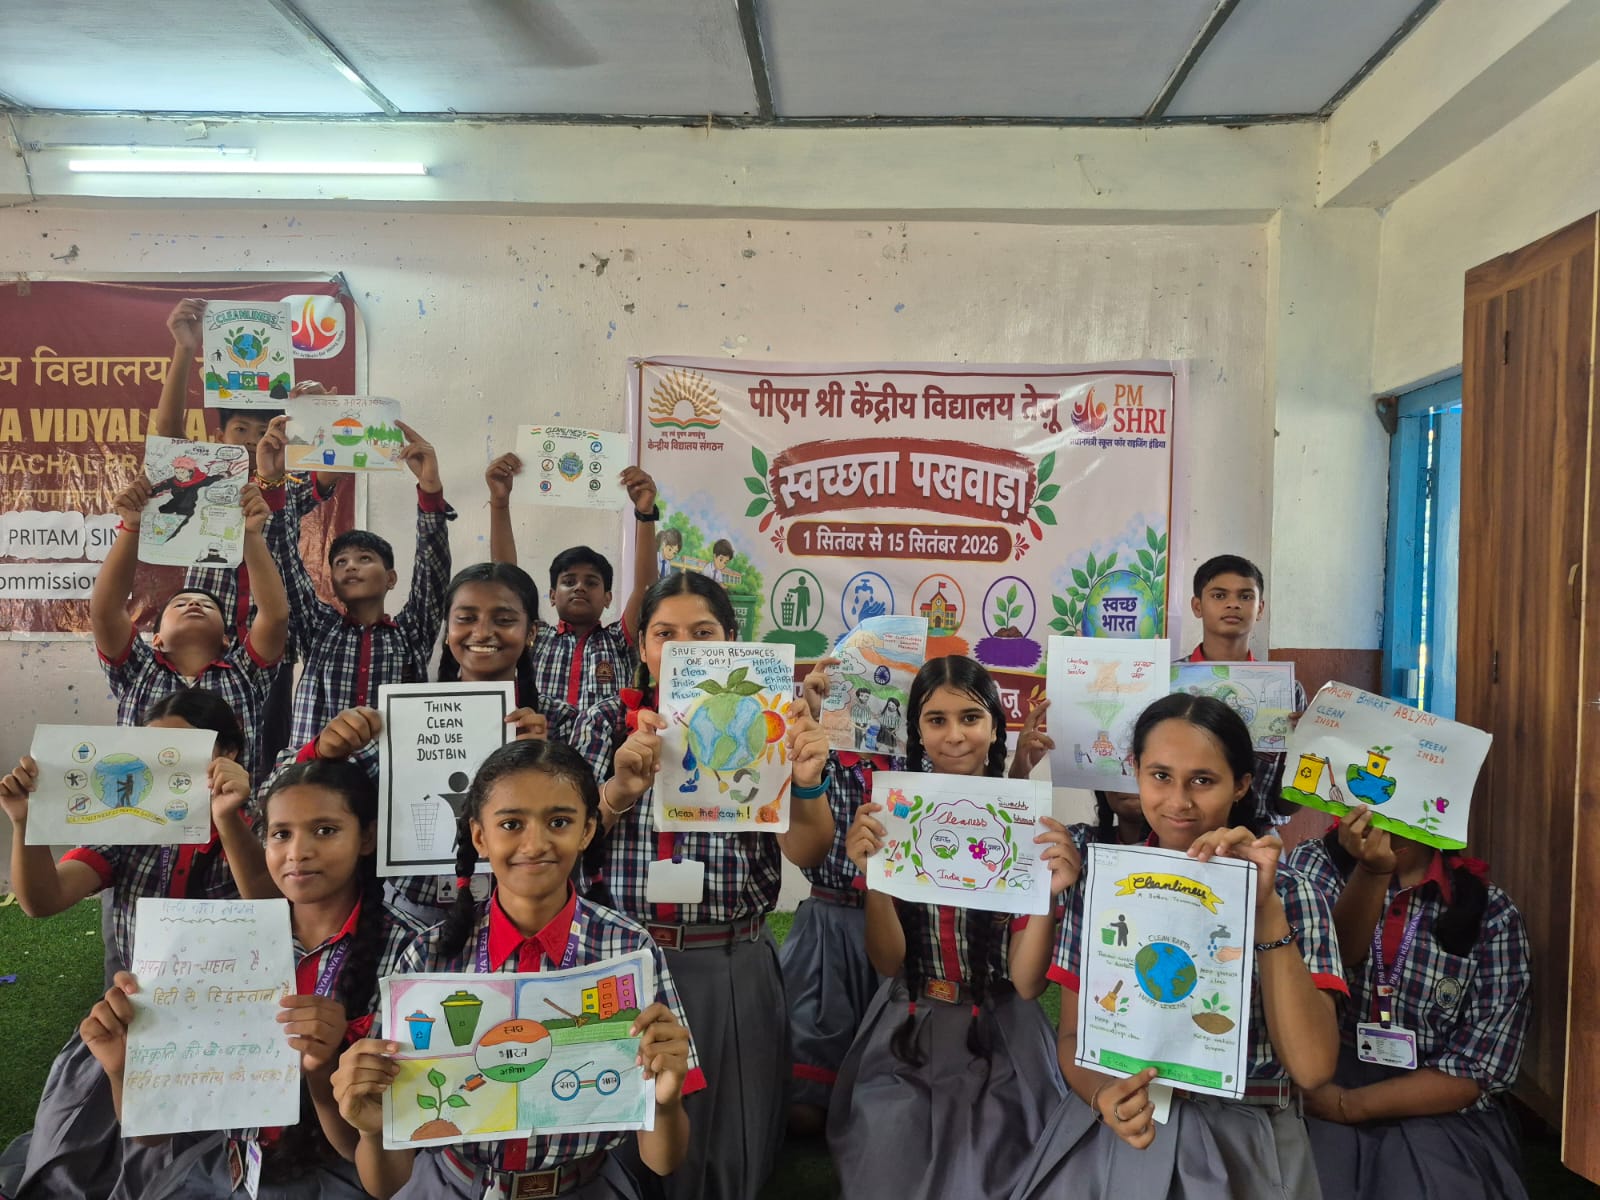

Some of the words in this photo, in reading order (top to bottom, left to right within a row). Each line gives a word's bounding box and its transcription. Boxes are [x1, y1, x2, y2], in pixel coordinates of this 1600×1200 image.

[31, 345, 171, 387] विद्यालय
[748, 379, 810, 424] पीएम
[815, 380, 845, 418] श्री
[850, 380, 917, 424] केंद्रीय
[923, 384, 1015, 421] विद्यालय
[1113, 384, 1144, 406] PM
[1113, 407, 1167, 434] SHRI
[671, 439, 698, 451] विद्यालय
[699, 440, 724, 451] संगठन
[1098, 437, 1113, 450] स्कूल
[779, 451, 900, 509] स्वच्छता
[909, 452, 1028, 519] पखवाड़ा
[9, 529, 79, 546] PRITAM
[803, 533, 811, 549] 1
[816, 525, 864, 551] सितंबर
[869, 527, 884, 552] से
[888, 533, 904, 551] 15
[909, 528, 957, 554] सितंबर
[961, 535, 999, 554] 2026
[1102, 597, 1138, 612] स्वच्छ
[1102, 615, 1138, 632] भारत
[672, 648, 697, 656] SAVE
[701, 647, 725, 657] YOUR
[728, 647, 775, 657] RESOURCES
[686, 658, 702, 666] ONE
[424, 700, 462, 712] THINK
[1316, 705, 1346, 719] CLEAN
[426, 716, 464, 729] CLEAN
[1313, 715, 1340, 729] INDIA
[1392, 706, 1438, 727] ABIYAN
[417, 733, 440, 745] AND
[445, 733, 463, 743] USE
[1418, 738, 1447, 753] GREEN
[417, 748, 467, 761] DUSTBIN
[1415, 750, 1445, 764] INDIA
[936, 869, 961, 882] India
[561, 942, 575, 967] TEZU
